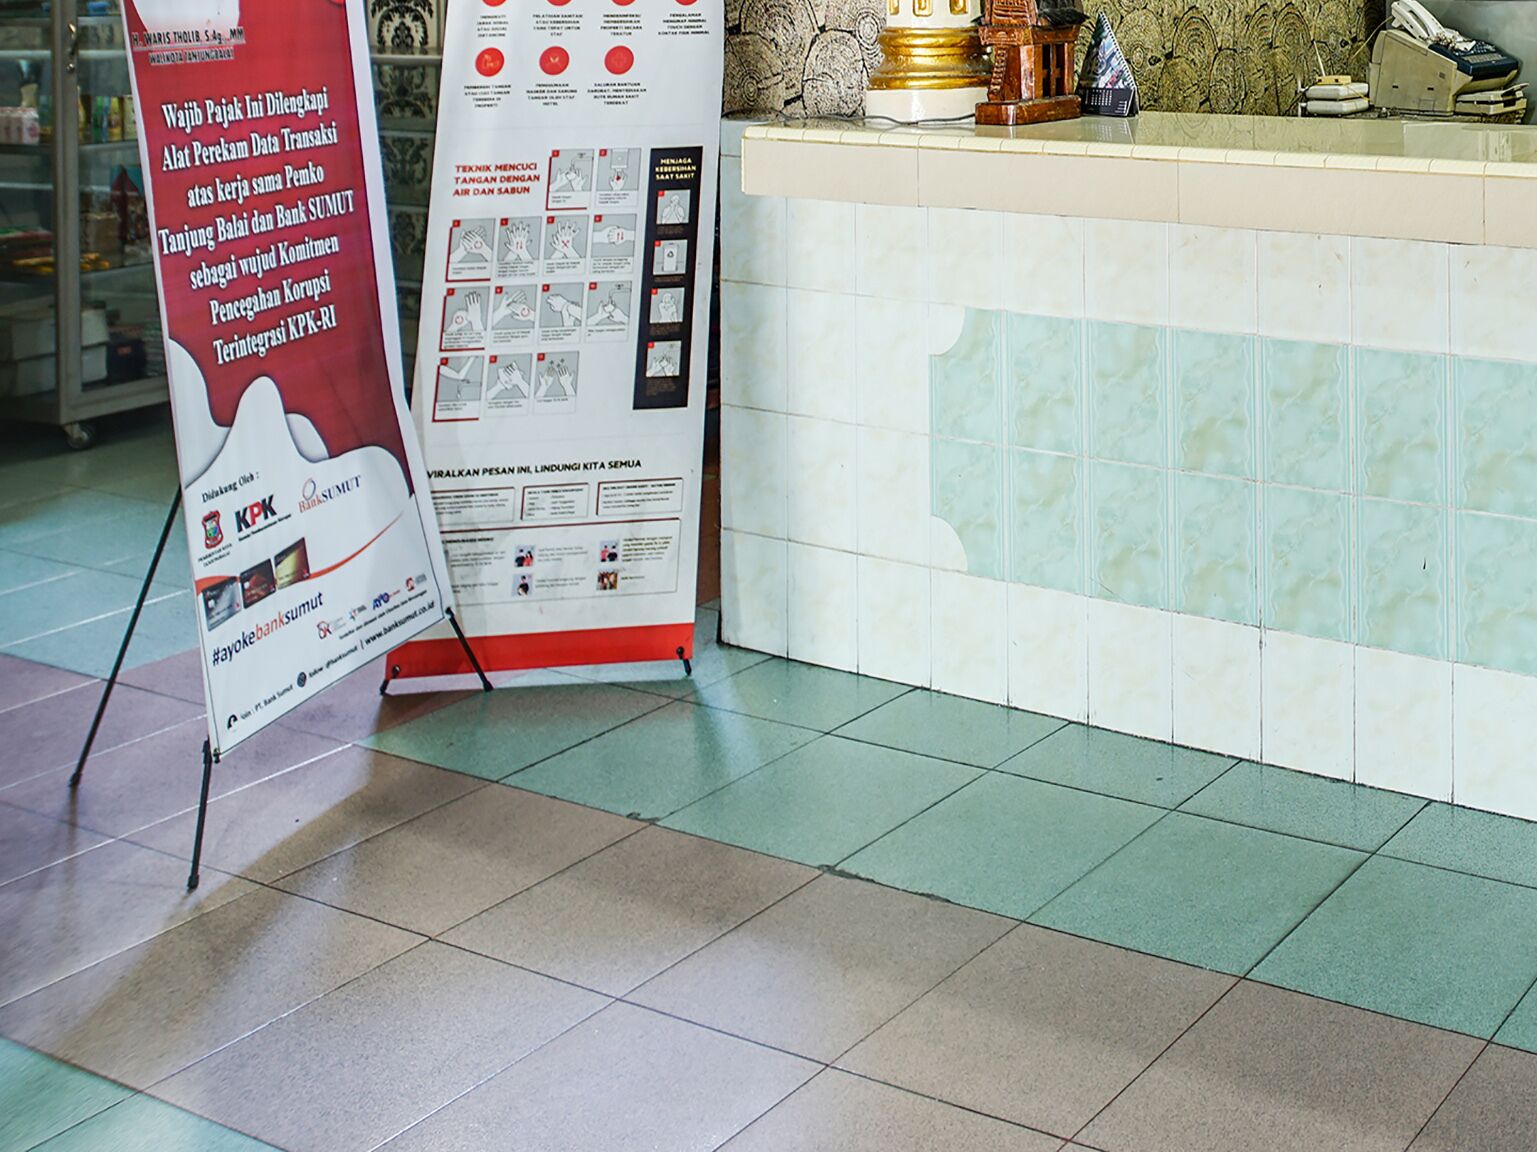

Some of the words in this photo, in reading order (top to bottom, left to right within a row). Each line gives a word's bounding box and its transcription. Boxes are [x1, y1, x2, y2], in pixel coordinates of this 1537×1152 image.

[144, 32, 171, 45] WARIS
[230, 29, 244, 39] MM
[150, 51, 183, 64] WALIKOTA
[162, 100, 203, 134] Wajib
[205, 97, 244, 129] Pajak
[245, 94, 264, 120] Ini
[265, 87, 329, 118] Dilengkapi
[162, 145, 191, 171] Alat
[192, 138, 249, 167] Perekam
[250, 133, 280, 157] Data
[281, 122, 339, 152] Transaksi
[187, 185, 214, 208] atas
[215, 174, 250, 204] kerja
[252, 173, 283, 195] sama
[284, 161, 325, 189] Pemko
[454, 176, 497, 185] TANGAN
[499, 174, 540, 183] DENGAN
[455, 164, 492, 173] TEKNIK
[495, 162, 537, 172] MENCUCI
[655, 165, 697, 173] KEBERSIHAN
[656, 173, 674, 181] SAAT
[675, 172, 695, 180] SAKIT
[453, 188, 471, 197] AIR
[473, 187, 495, 196] DAN
[497, 186, 530, 195] SABUN
[158, 225, 216, 257] Tanjung
[215, 212, 250, 243] Balai
[251, 210, 274, 234] dan
[277, 200, 308, 229] Bank
[309, 190, 355, 221] SUMUT
[190, 255, 238, 290] sebagai
[239, 246, 277, 279] wujud
[278, 235, 340, 267] Komitmen
[209, 288, 281, 326] Pencegahan
[282, 269, 331, 303] Korupsi
[213, 320, 287, 365] Terintegrasi
[287, 304, 337, 341] KPK-RI
[427, 468, 480, 480] VIRALKAN
[482, 466, 514, 477] PESAN
[517, 465, 533, 476] INI,
[534, 462, 582, 473] LINDUNGI
[583, 461, 606, 472] KITA
[608, 459, 642, 470] SEMUA
[202, 481, 238, 503] Didukung
[238, 473, 255, 488] Oleh
[234, 494, 278, 534] KPK
[212, 592, 324, 667] #ayokebanksumut
